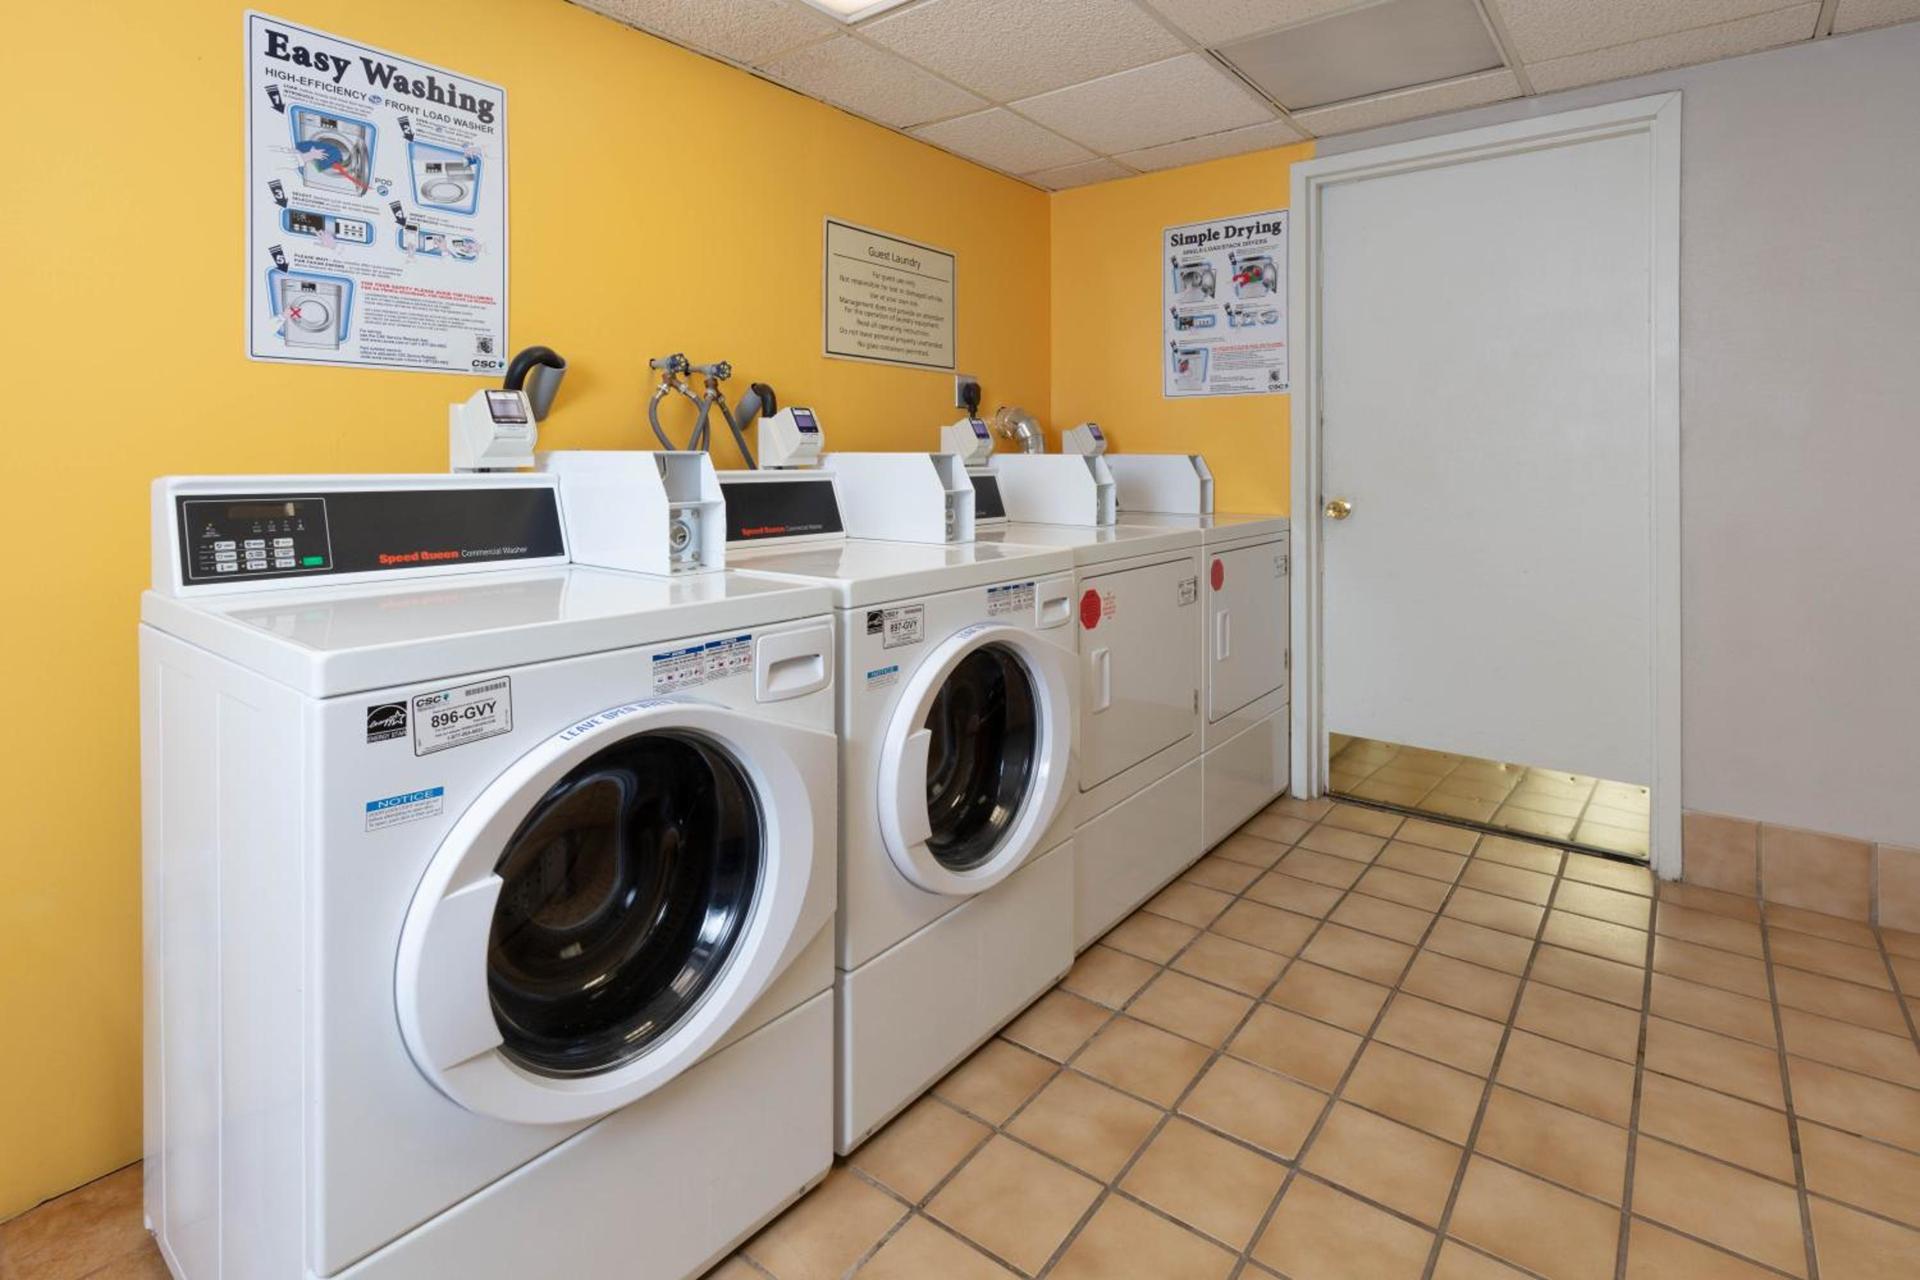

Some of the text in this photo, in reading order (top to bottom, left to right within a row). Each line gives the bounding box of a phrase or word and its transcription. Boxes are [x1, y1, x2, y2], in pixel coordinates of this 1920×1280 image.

[264, 29, 496, 124] Easy Washing
[265, 67, 367, 101] HIGH-EFFICIENCY
[385, 99, 419, 115] FRONT
[423, 109, 452, 124] LOAD
[453, 117, 494, 135] WASHER
[375, 177, 392, 187] POD
[1170, 220, 1283, 248] Simple Drying
[868, 246, 920, 270] Guest Laundry
[471, 359, 496, 369] CSC
[378, 545, 528, 566] Speed Queen Commercial Washer
[415, 694, 442, 708] CSC
[431, 701, 498, 728] 896-GVY
[559, 706, 638, 742] LEAVE OPEN
[378, 789, 433, 808] NOTICE
